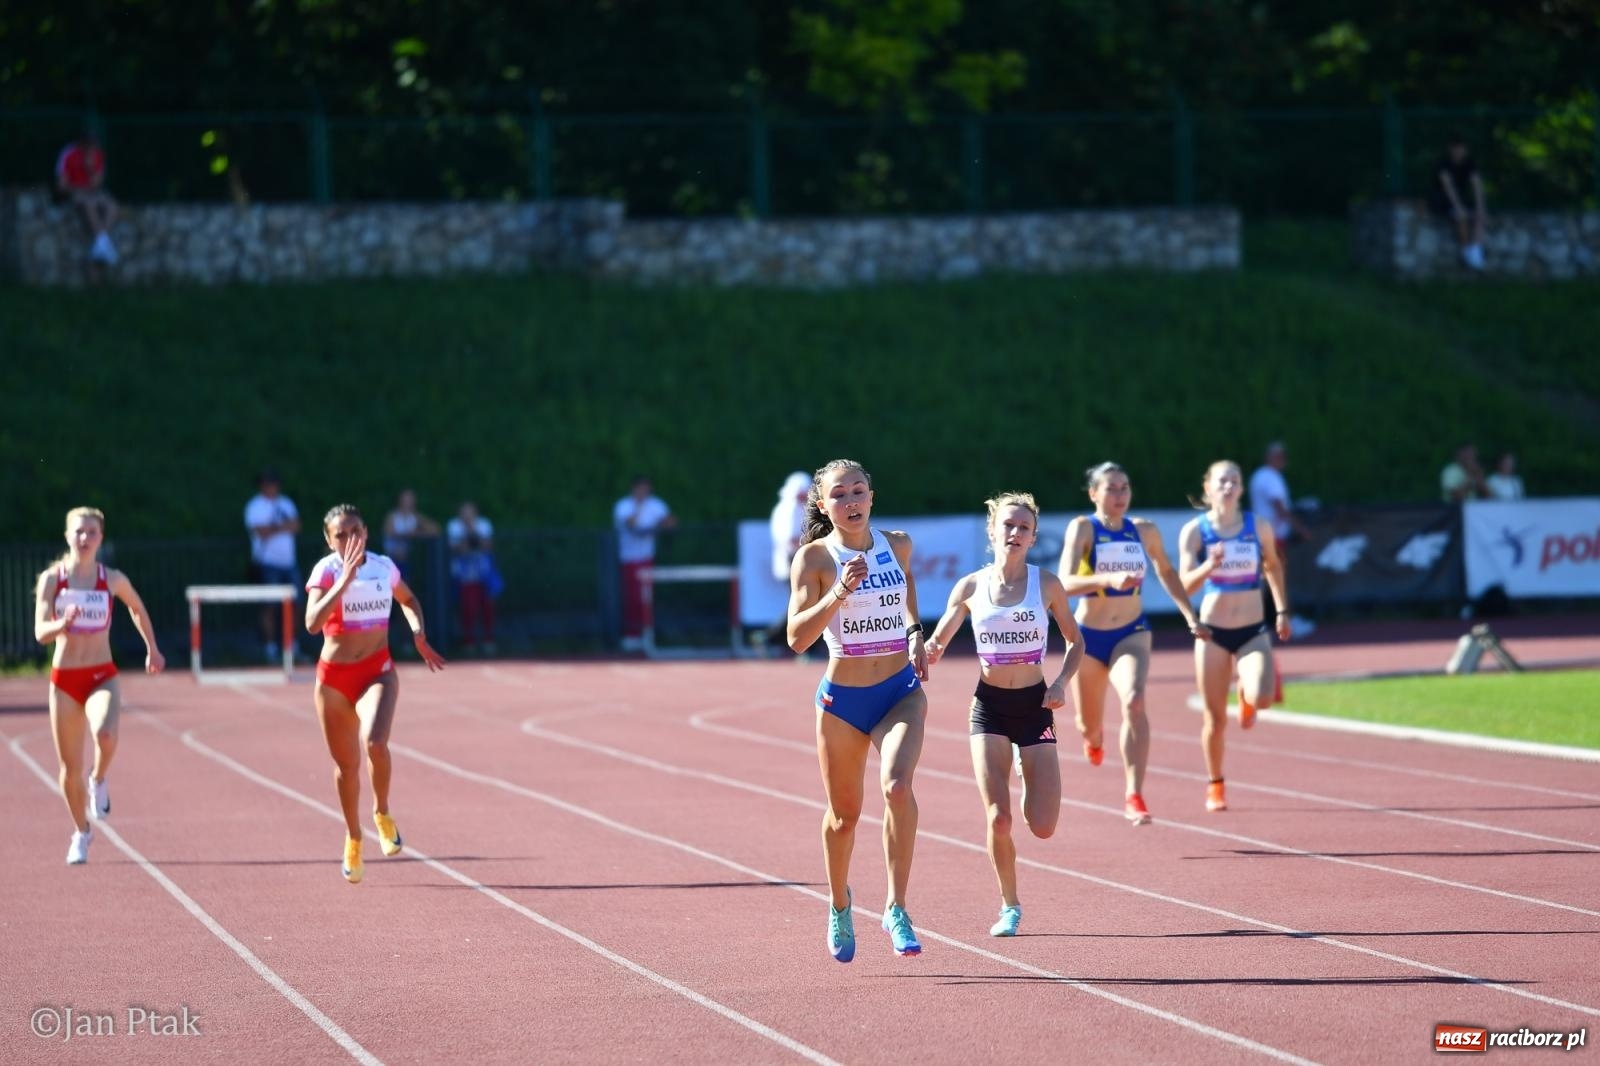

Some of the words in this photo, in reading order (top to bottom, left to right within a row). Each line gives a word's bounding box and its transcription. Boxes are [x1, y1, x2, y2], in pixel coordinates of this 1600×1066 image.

[1098, 561, 1144, 571] OLEKSIUK
[855, 569, 905, 590] ECHIA
[879, 593, 901, 607] 105
[843, 612, 904, 634] ŠAFÁROVÁ
[1012, 611, 1036, 622] 305
[980, 628, 1039, 644] GYMERSKÁ
